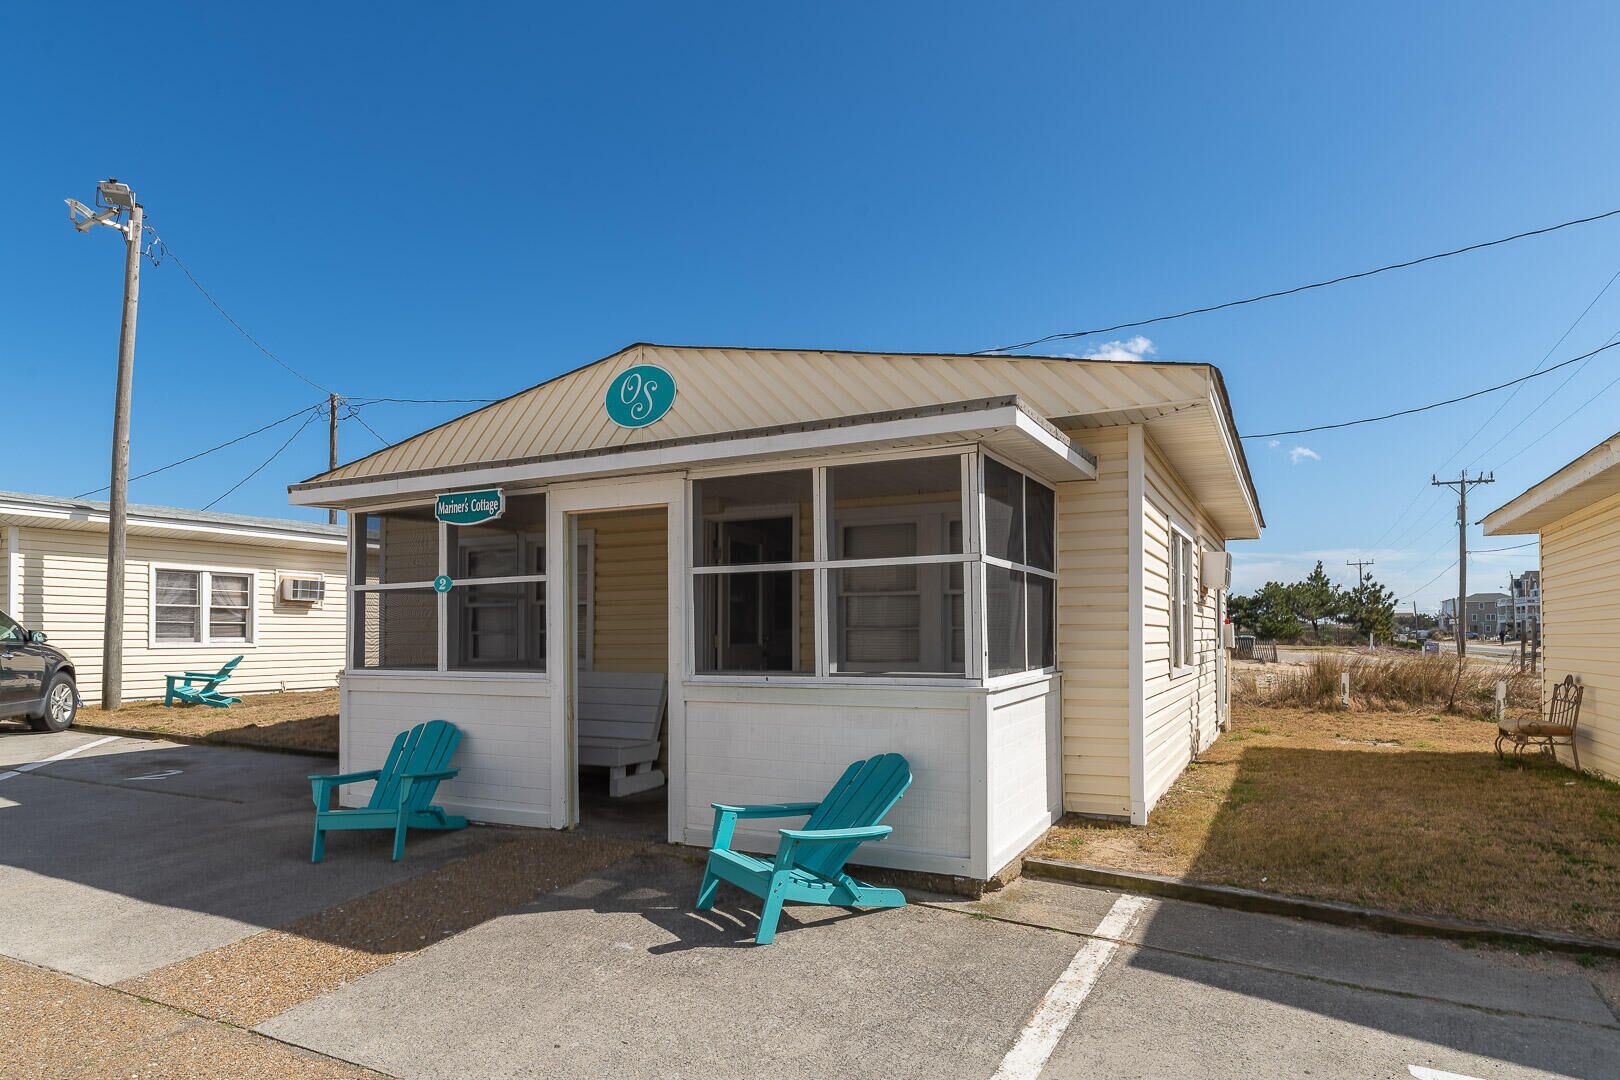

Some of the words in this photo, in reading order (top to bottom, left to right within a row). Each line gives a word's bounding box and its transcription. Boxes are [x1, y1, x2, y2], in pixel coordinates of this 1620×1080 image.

[437, 497, 469, 515] Mariner's
[470, 498, 499, 515] Cottage
[438, 577, 447, 590] 2
